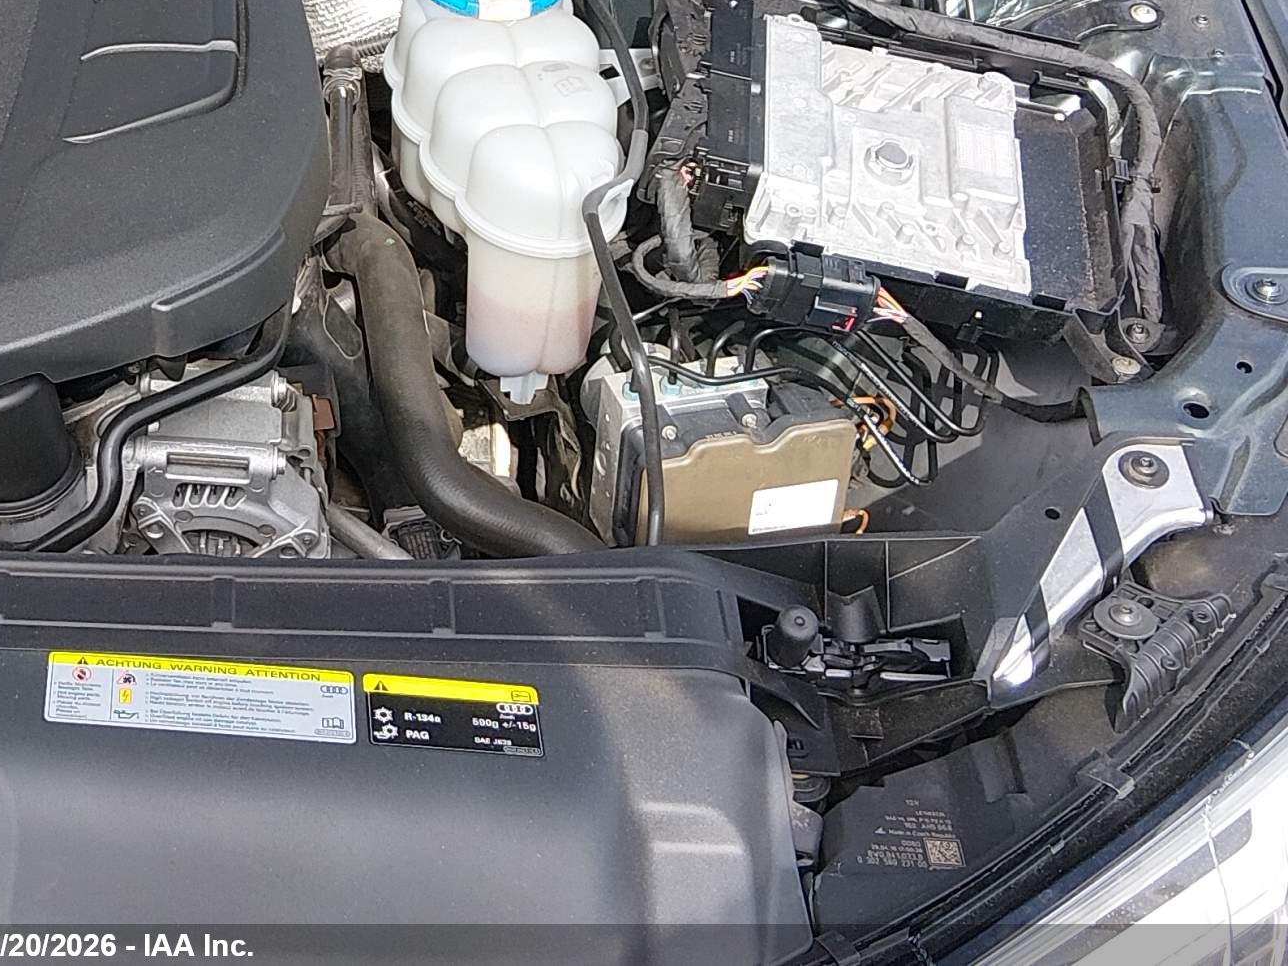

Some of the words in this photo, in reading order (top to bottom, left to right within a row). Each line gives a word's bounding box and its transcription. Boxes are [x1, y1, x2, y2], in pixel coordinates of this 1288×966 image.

[96, 658, 162, 670] ACHTUNG
[170, 663, 238, 676] WARNING
[245, 668, 321, 682] ATTENTION
[404, 711, 442, 724] R-134a
[405, 729, 430, 741] PAG
